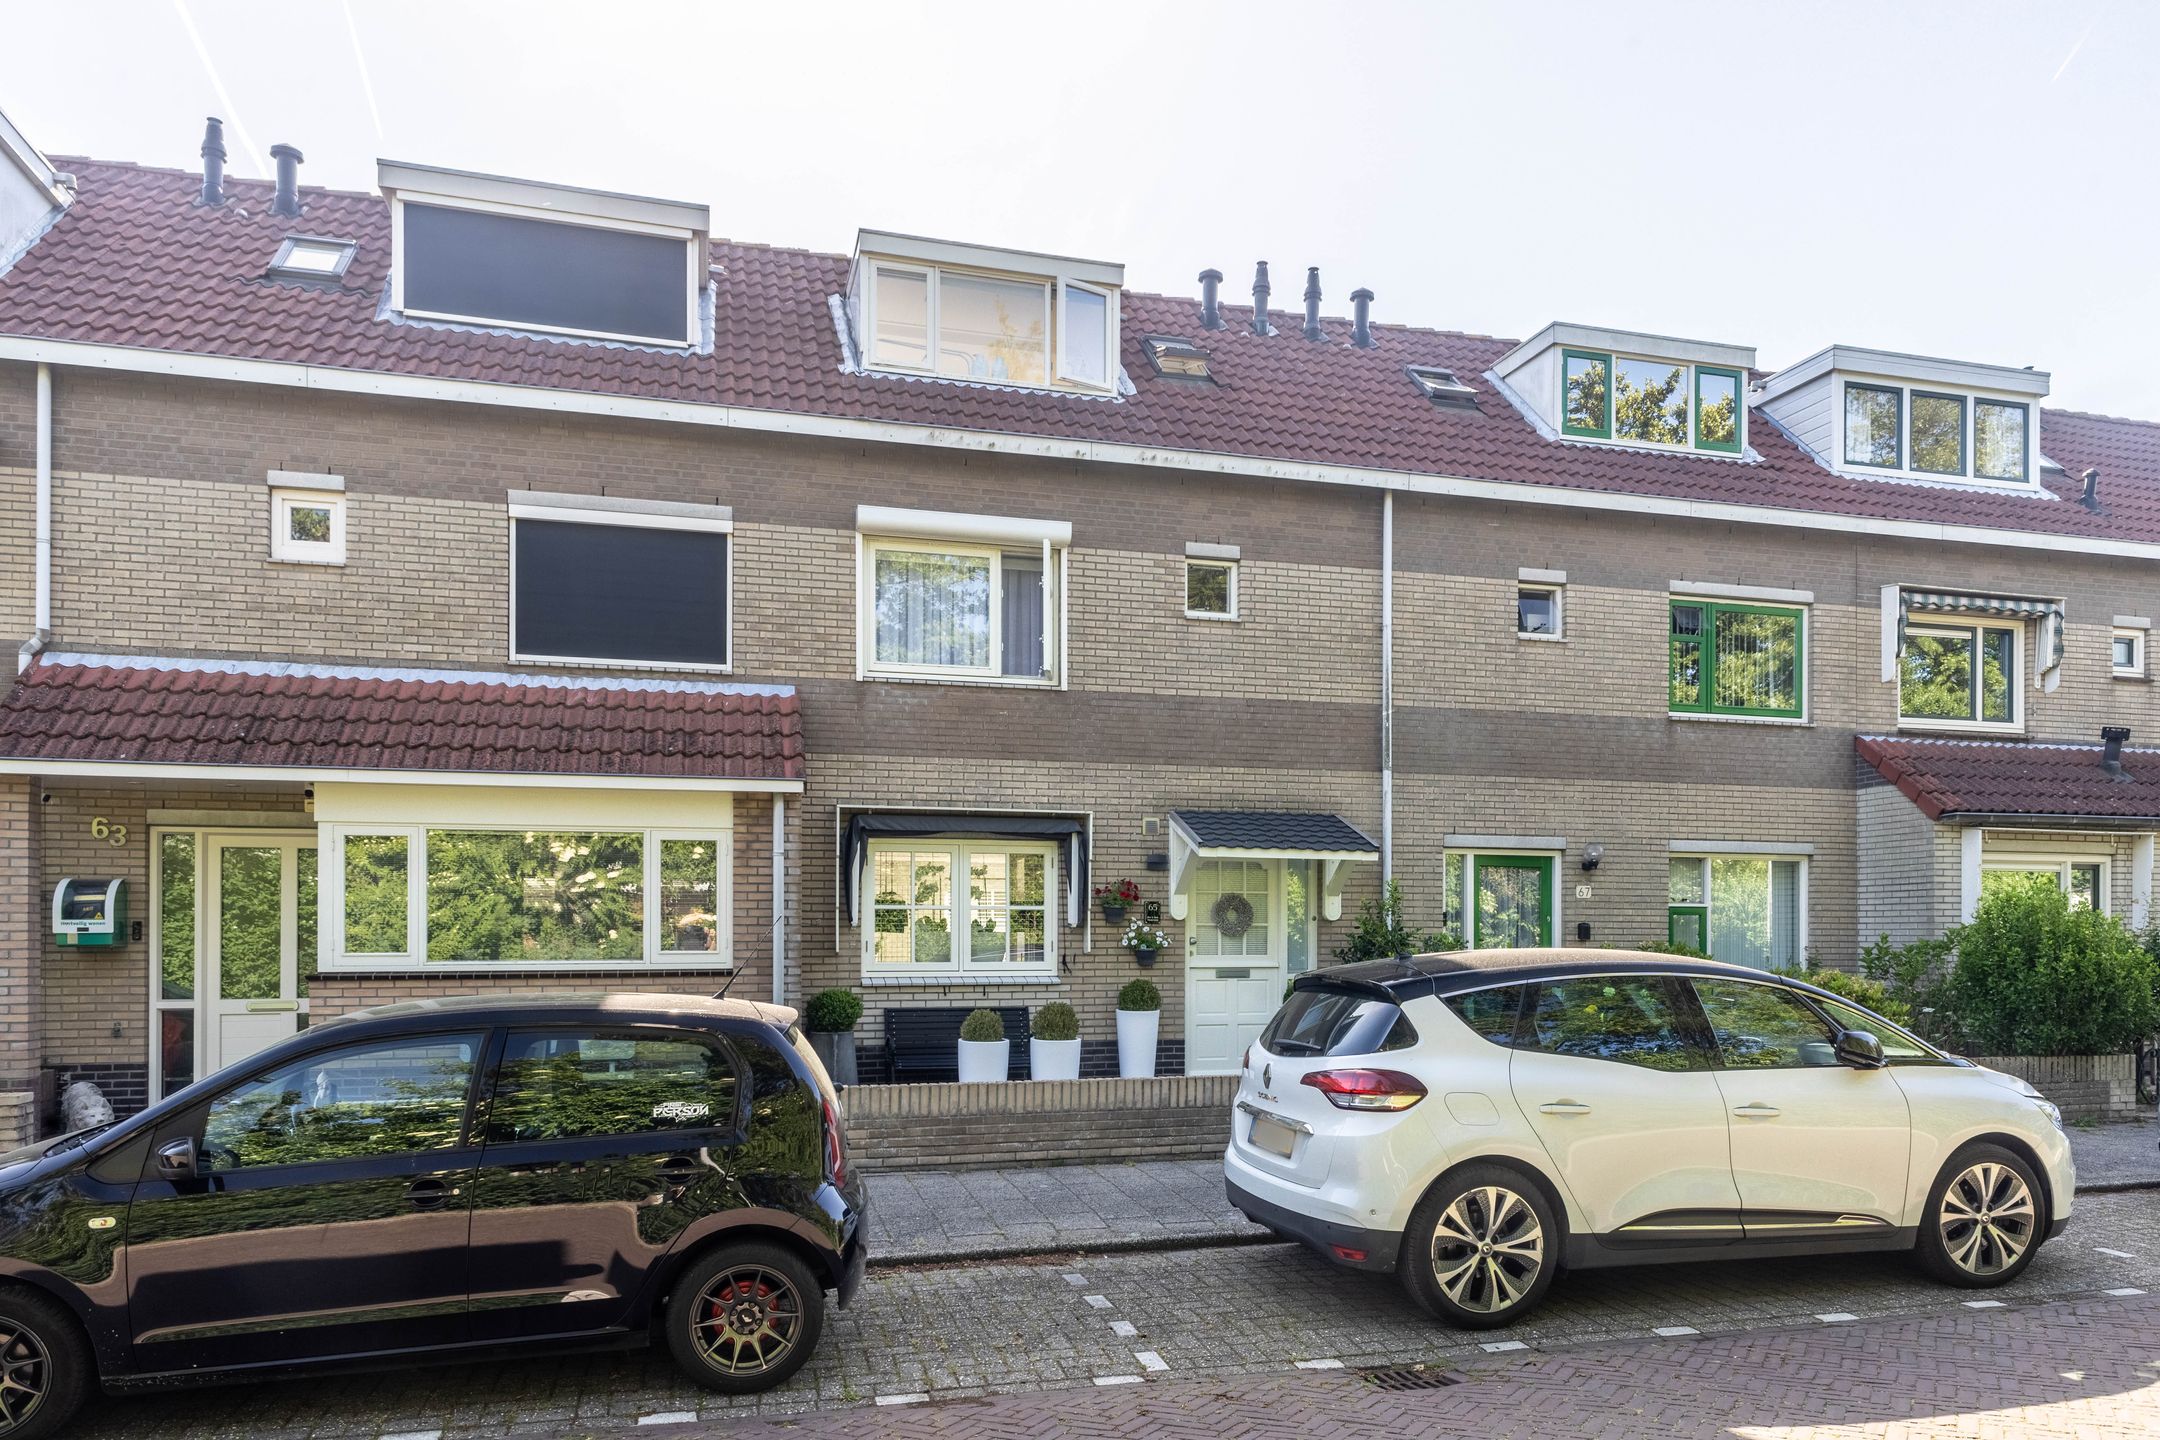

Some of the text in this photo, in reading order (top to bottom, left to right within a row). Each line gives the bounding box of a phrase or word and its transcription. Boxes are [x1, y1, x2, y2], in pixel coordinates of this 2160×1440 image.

[91, 817, 127, 846] 63
[1578, 887, 1590, 896] 67
[653, 1105, 709, 1117] PERSON
